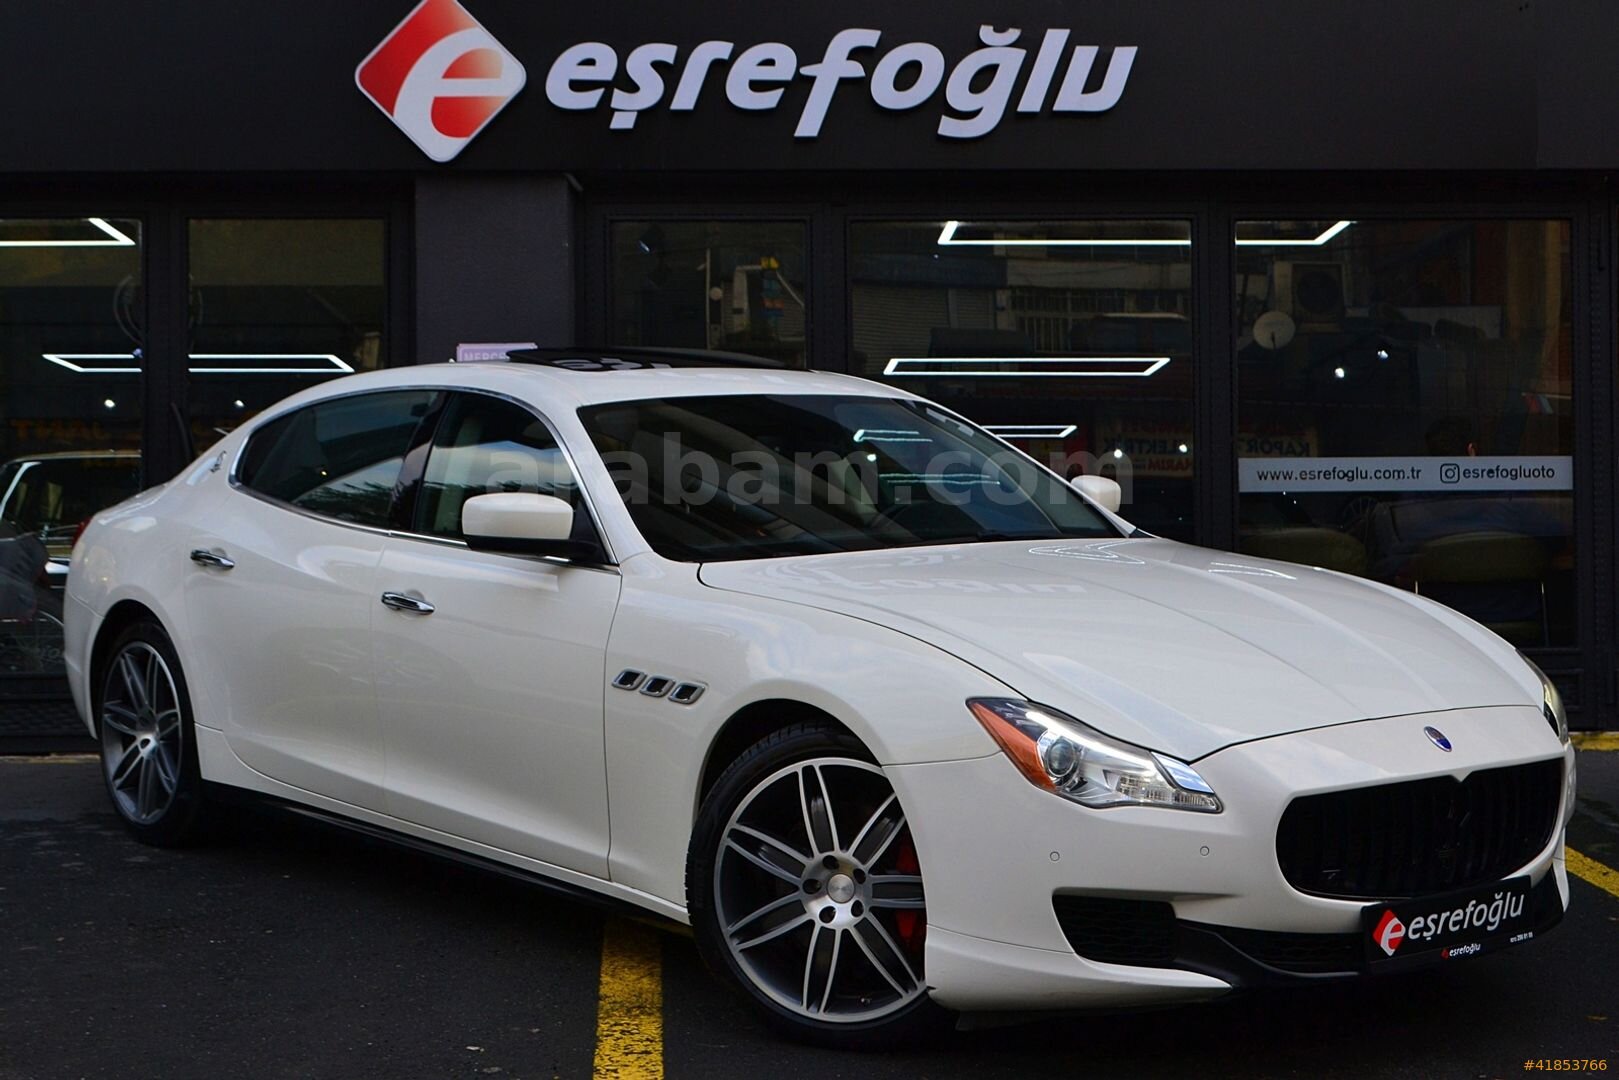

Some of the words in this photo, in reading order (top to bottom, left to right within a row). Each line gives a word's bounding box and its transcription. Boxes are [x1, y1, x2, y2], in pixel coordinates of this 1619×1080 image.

[545, 24, 1138, 138] eşrefoğlu
[463, 351, 507, 361] MERCE
[1255, 465, 1422, 483] www.esrefoglu.com.tr
[1462, 463, 1556, 482] esrefogluoto
[1407, 891, 1526, 941] eşrefoğlu
